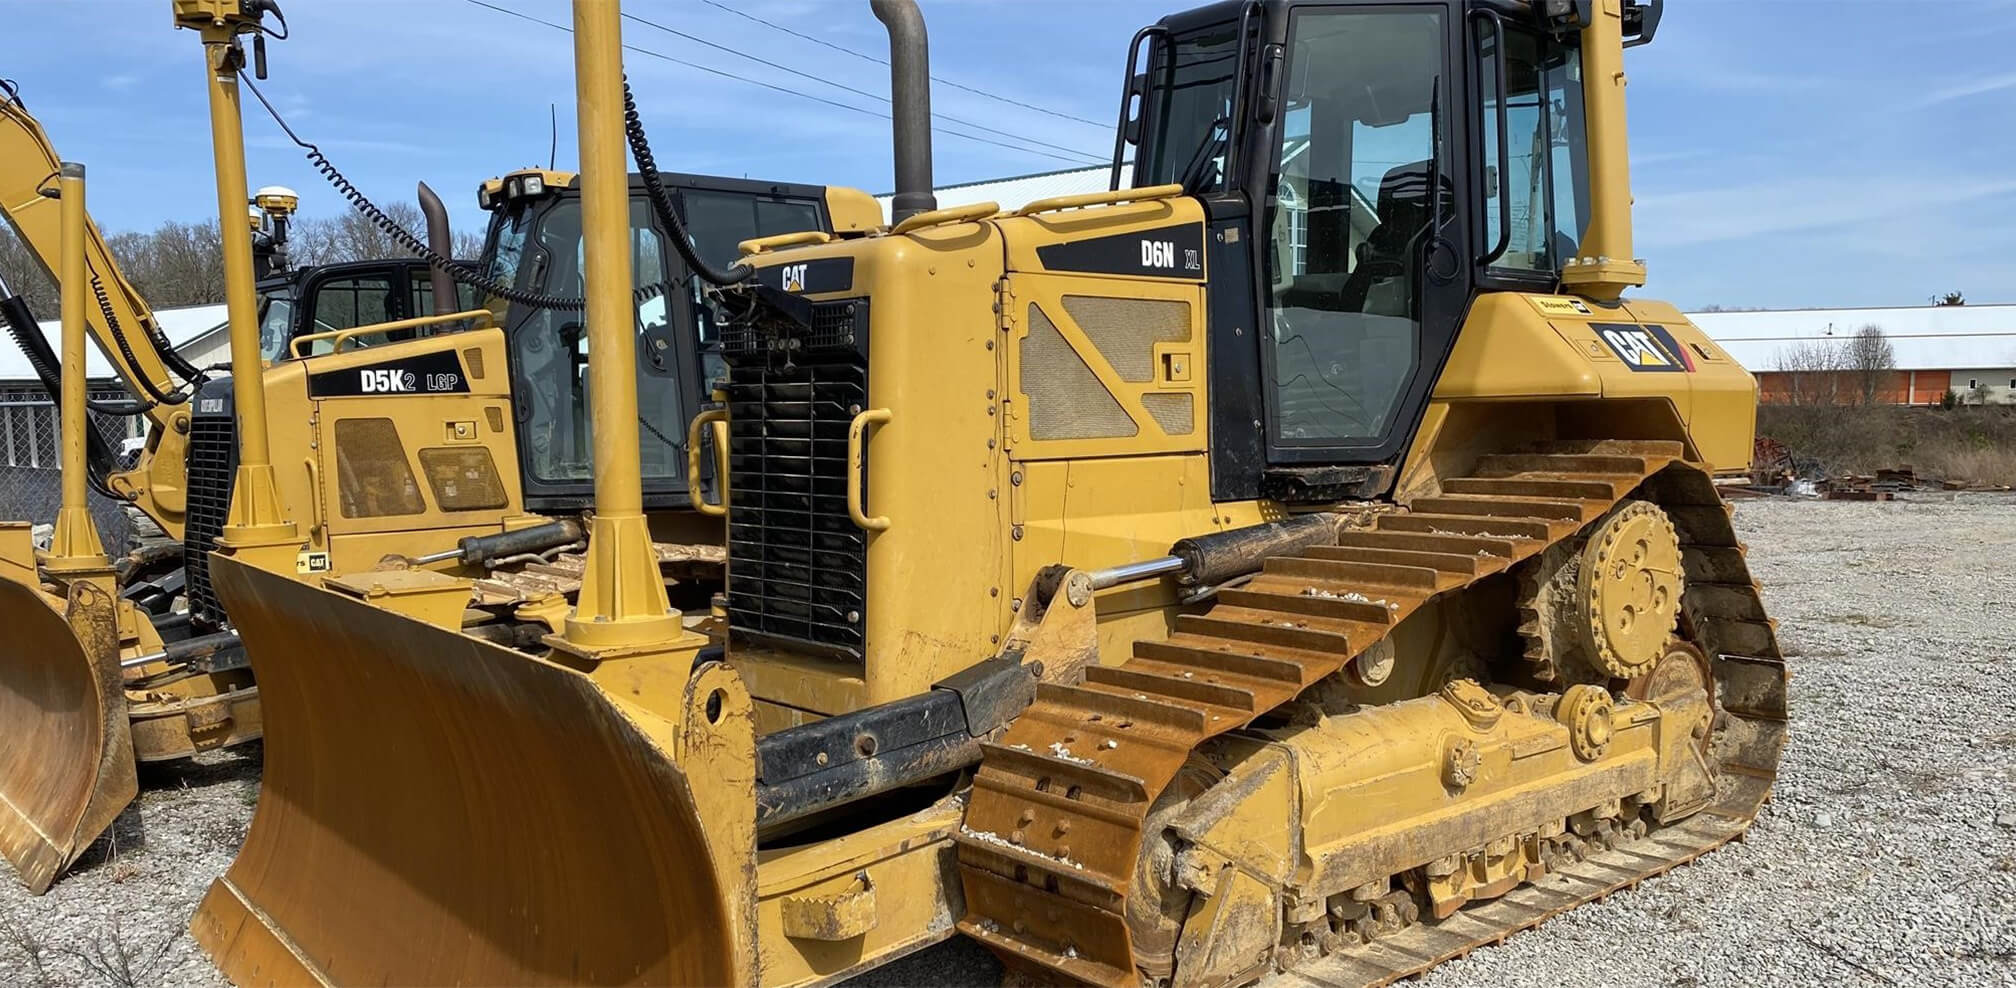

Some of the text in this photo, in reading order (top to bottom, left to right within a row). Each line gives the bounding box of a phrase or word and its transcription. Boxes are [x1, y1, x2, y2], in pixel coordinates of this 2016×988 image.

[1141, 240, 1200, 269] D6N XL
[782, 264, 808, 292] CAT
[1603, 330, 1671, 366] CAT
[360, 369, 458, 392] D5K2 LGP
[310, 558, 325, 567] CAT
